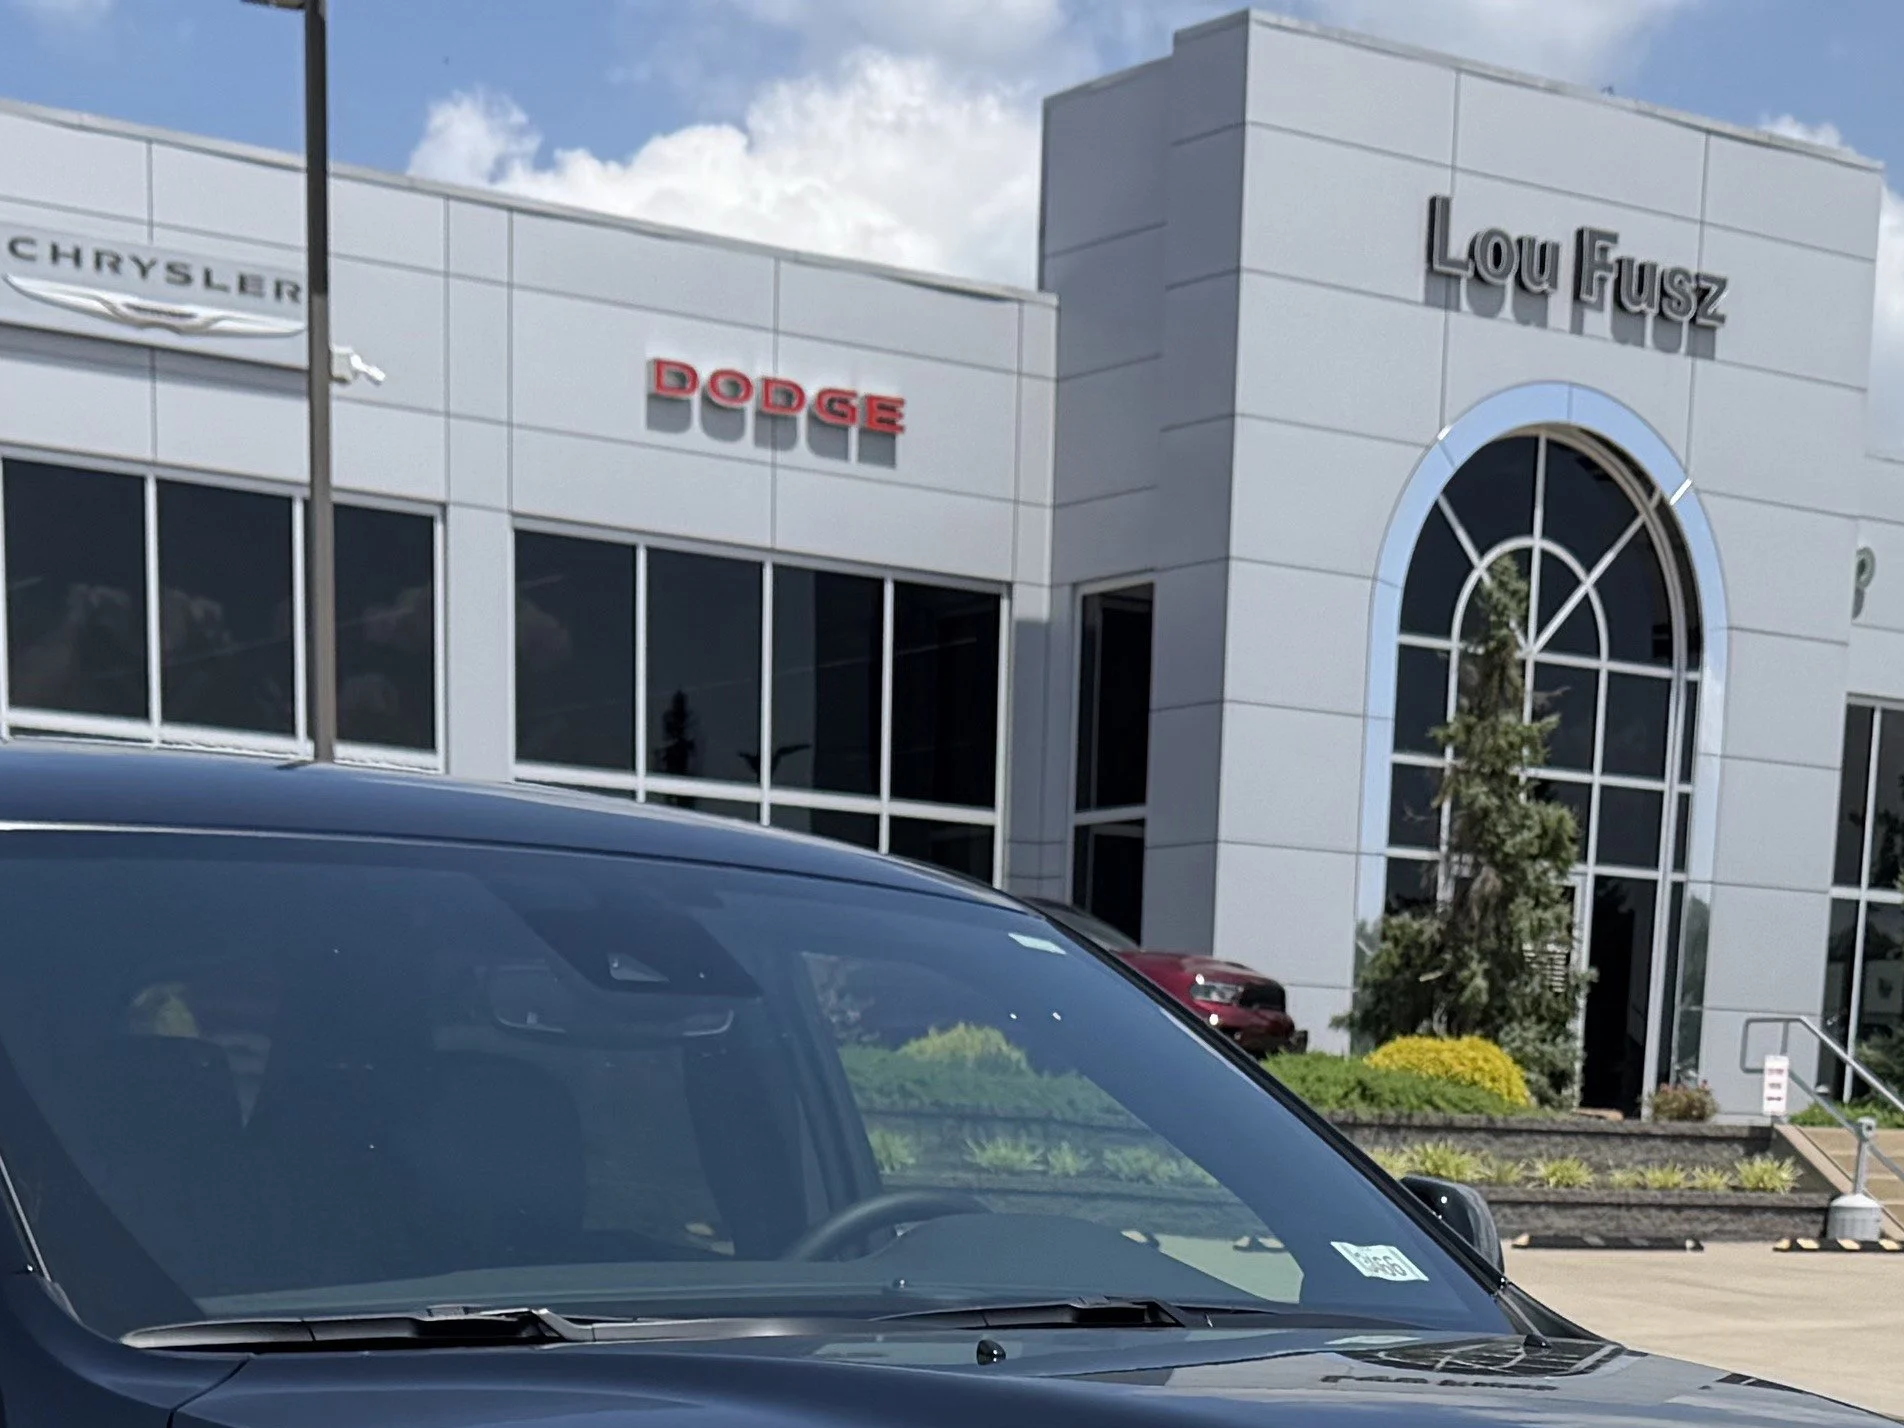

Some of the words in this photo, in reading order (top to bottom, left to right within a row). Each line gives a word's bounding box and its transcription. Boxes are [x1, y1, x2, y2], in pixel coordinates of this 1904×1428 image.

[7, 236, 303, 303] CHRYSLER
[1426, 195, 1560, 294] Lou
[1573, 225, 1729, 327] Fusz
[647, 357, 906, 434] DODGE
